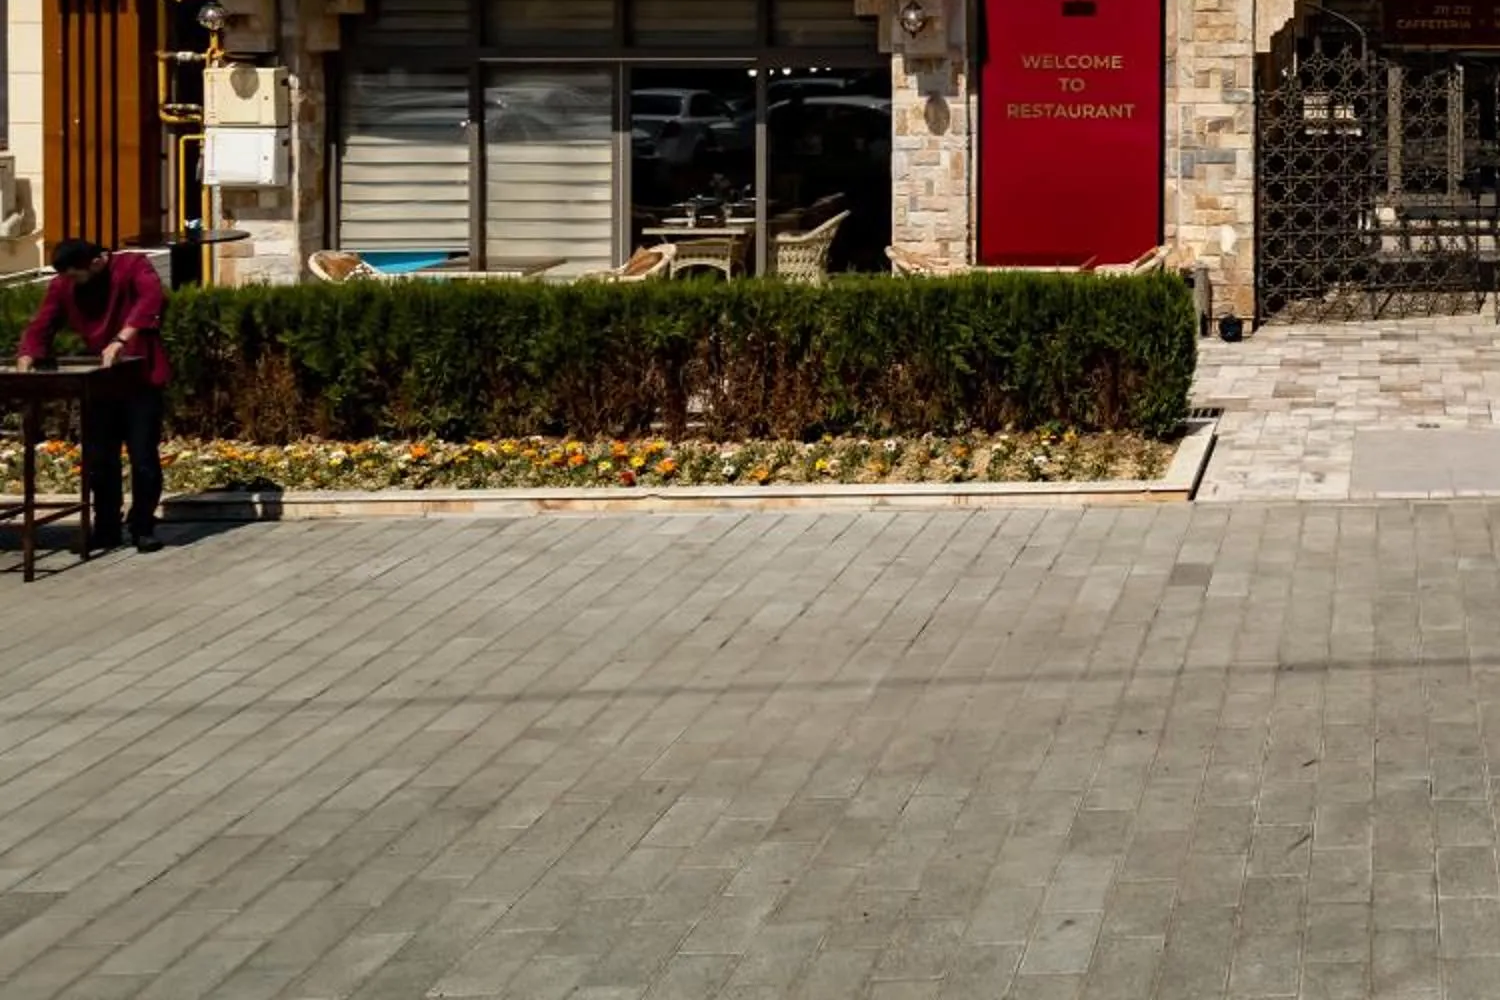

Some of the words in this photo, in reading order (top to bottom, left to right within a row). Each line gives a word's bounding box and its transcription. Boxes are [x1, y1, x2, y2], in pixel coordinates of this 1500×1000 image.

[1022, 55, 1124, 69] WELCOME
[1058, 77, 1086, 92] TO
[1007, 103, 1136, 119] RESTAURANT
